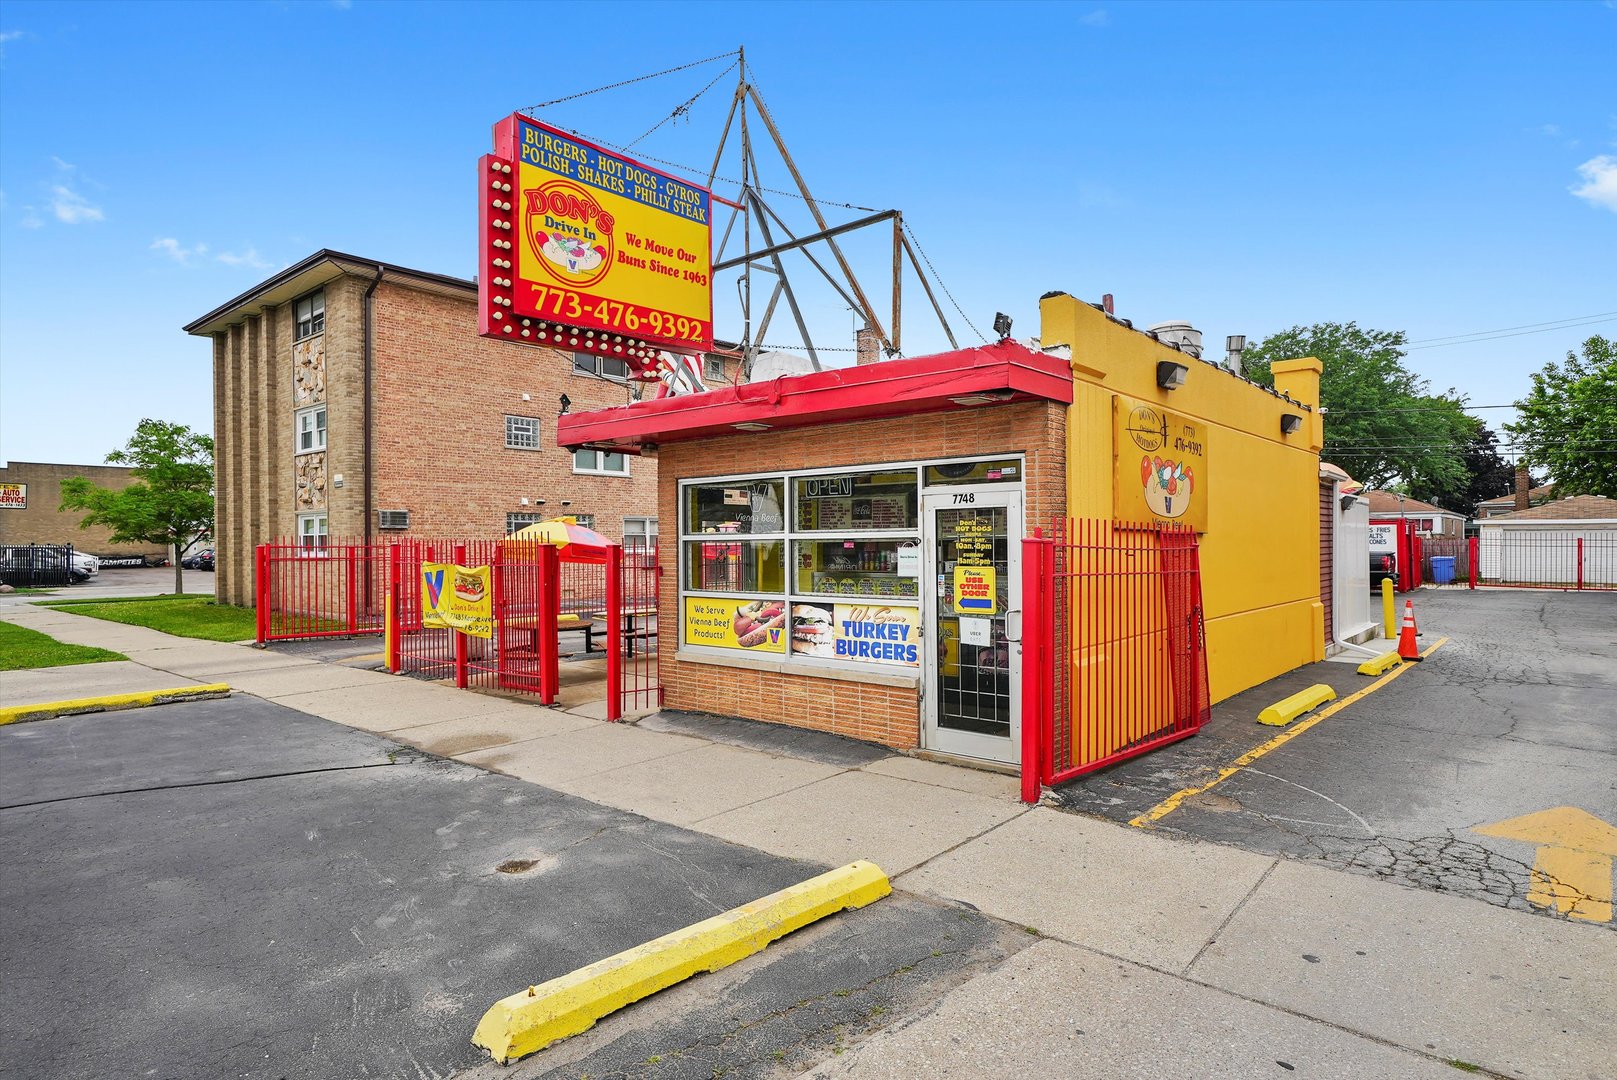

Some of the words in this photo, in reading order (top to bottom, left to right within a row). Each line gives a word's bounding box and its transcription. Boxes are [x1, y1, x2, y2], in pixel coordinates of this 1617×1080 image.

[525, 127, 587, 164] BURGERS
[598, 155, 623, 177] HOT
[625, 166, 657, 190] DOGS
[666, 182, 700, 205] GYROS
[577, 164, 624, 193] SHAKES
[634, 184, 670, 209] PHILLY
[673, 199, 706, 222] STEAK
[523, 188, 615, 235] DON'S
[544, 215, 580, 235] Drive
[583, 227, 597, 240] In
[625, 232, 642, 248] We
[644, 238, 674, 257] Move
[676, 248, 697, 263] Our
[617, 250, 646, 269] Buns
[649, 259, 679, 278] Since
[682, 270, 707, 286] 1963
[531, 284, 703, 341] 773-476-9392
[1183, 424, 1196, 438] (773)
[1174, 437, 1202, 456] 476-9392
[807, 478, 849, 496] OPEN
[952, 493, 975, 504] 7748
[735, 513, 759, 521] Vienna
[761, 513, 779, 523] Beef
[694, 605, 704, 613] We
[706, 605, 725, 615] Serve
[849, 606, 871, 622] We
[689, 617, 712, 626] Vienna
[714, 618, 730, 629] Beef
[842, 621, 910, 641] TURKEY
[694, 628, 725, 639] Products!
[836, 638, 917, 662] BURGERS
